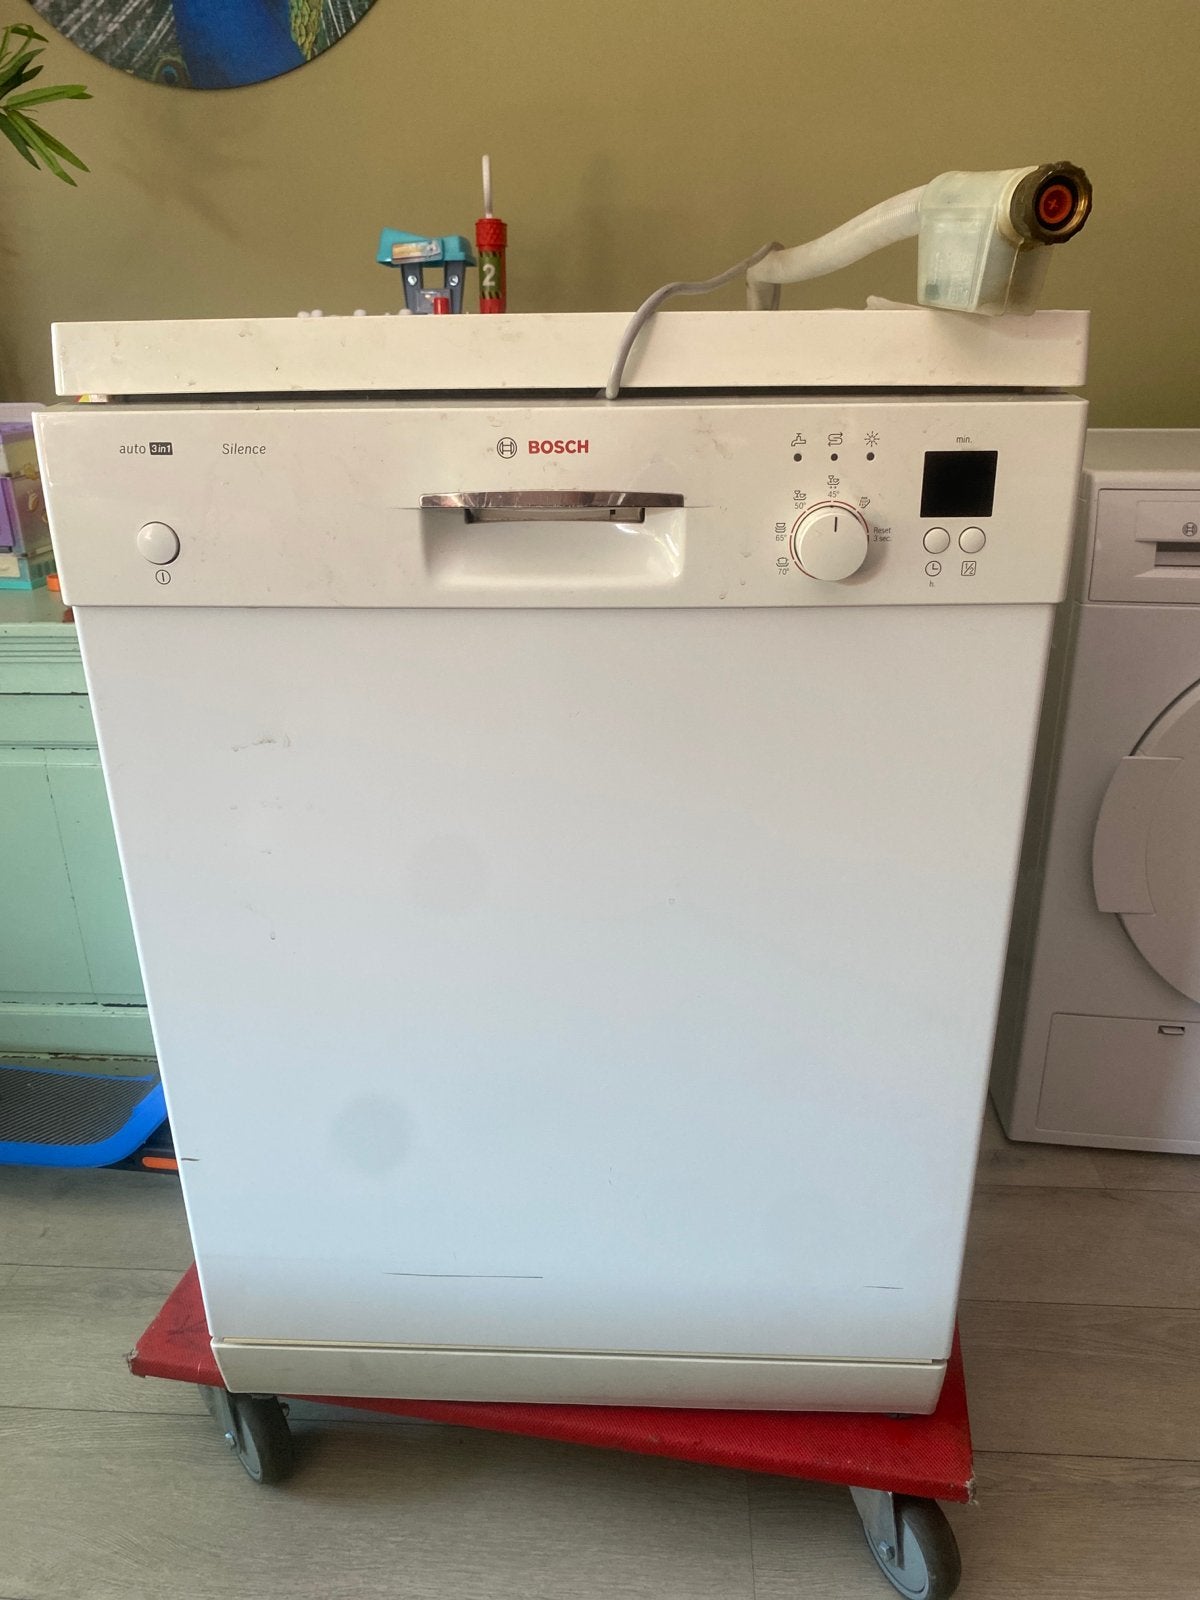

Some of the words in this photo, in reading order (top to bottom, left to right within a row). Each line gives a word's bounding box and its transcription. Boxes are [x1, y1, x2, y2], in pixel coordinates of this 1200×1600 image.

[482, 263, 496, 287] 2
[956, 436, 972, 444] min.
[119, 443, 146, 454] auto
[150, 444, 172, 454] 3in1
[222, 443, 266, 455] Silence
[528, 440, 589, 454] BOSCH
[828, 490, 840, 498] 45°
[794, 502, 807, 510] 50°
[775, 534, 788, 542] 65°
[778, 567, 790, 576] 70°
